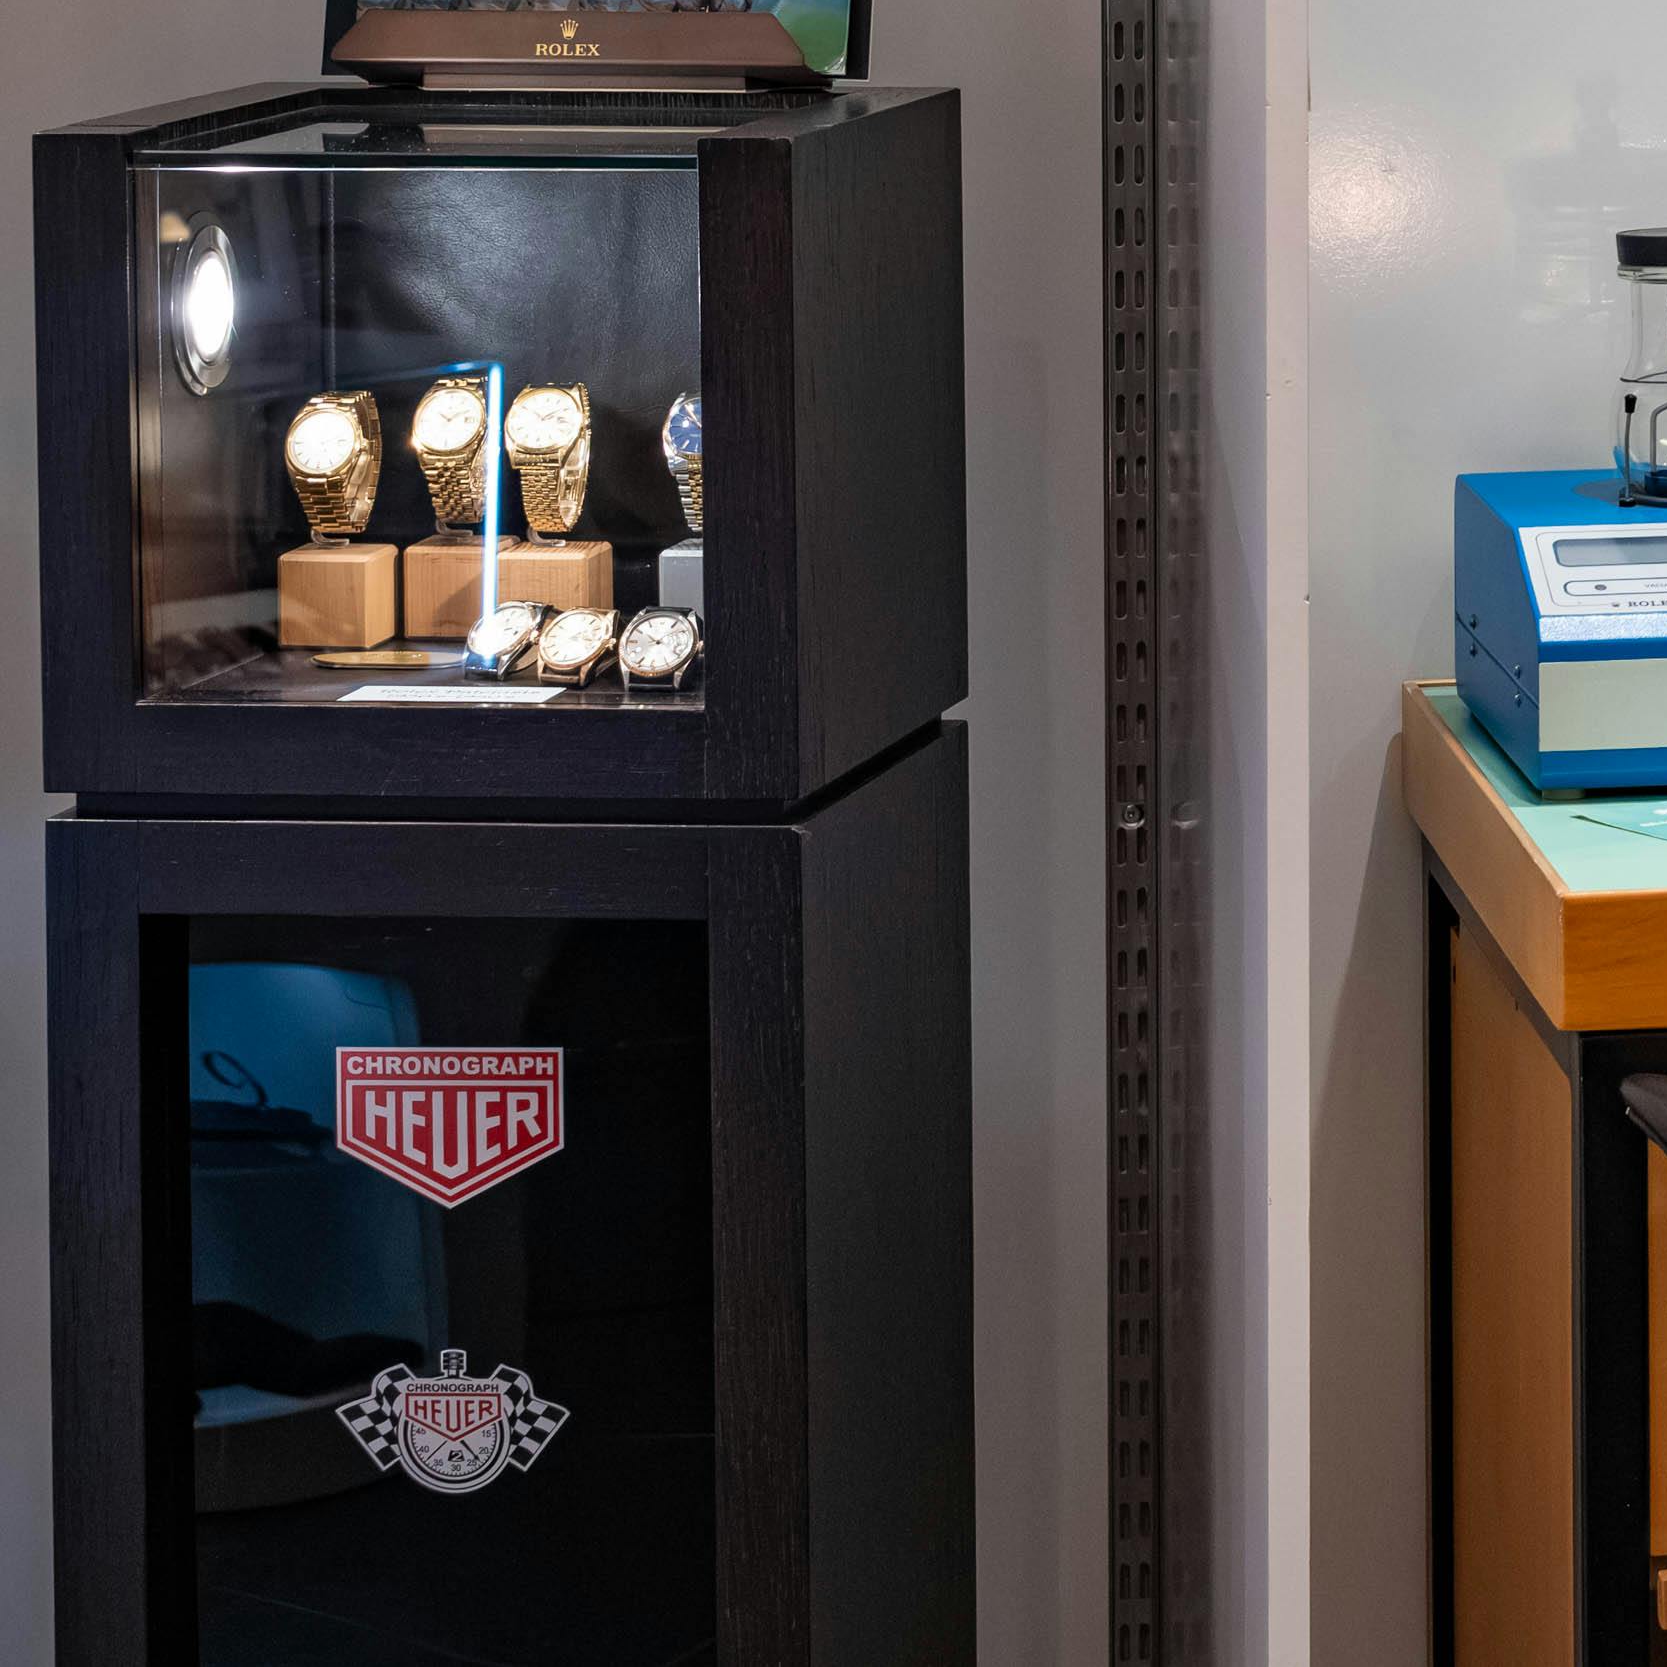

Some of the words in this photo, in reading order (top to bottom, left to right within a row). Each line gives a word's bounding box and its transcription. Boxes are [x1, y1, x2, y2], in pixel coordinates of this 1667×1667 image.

[535, 43, 600, 56] ROLEX
[346, 1056, 553, 1075] CHRONOGRAPH
[365, 1091, 541, 1179] HEUER
[407, 1383, 499, 1392] CHRONOGRAPH
[414, 1399, 494, 1432] HEUER
